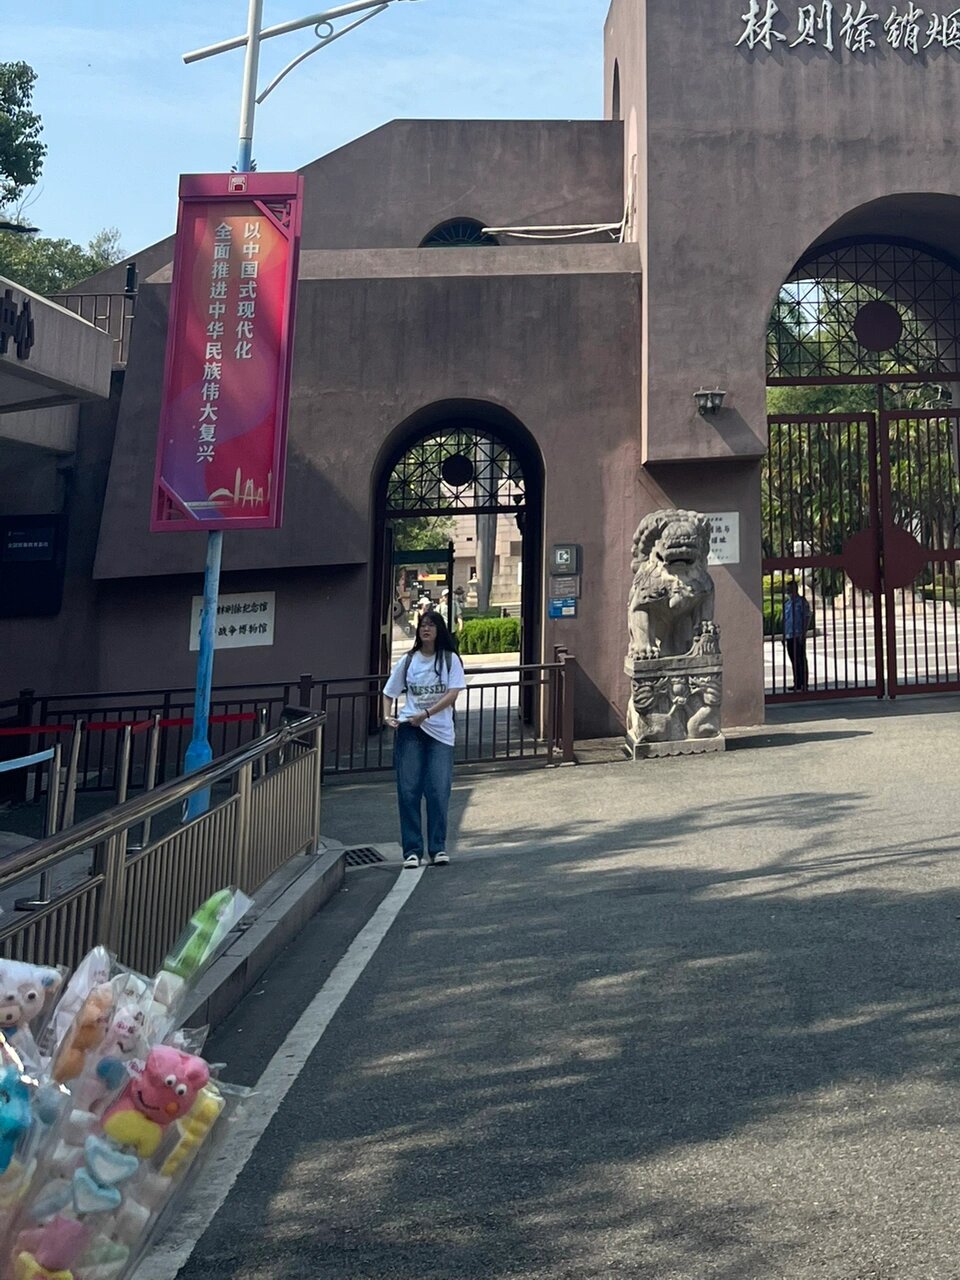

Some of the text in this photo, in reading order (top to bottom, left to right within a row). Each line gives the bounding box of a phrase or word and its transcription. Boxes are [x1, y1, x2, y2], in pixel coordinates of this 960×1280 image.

[196, 222, 232, 463] 全面推进中华民族伟大复兴
[234, 222, 261, 360] 以中国式现代化
[199, 601, 268, 616] 林则徐纪念馆
